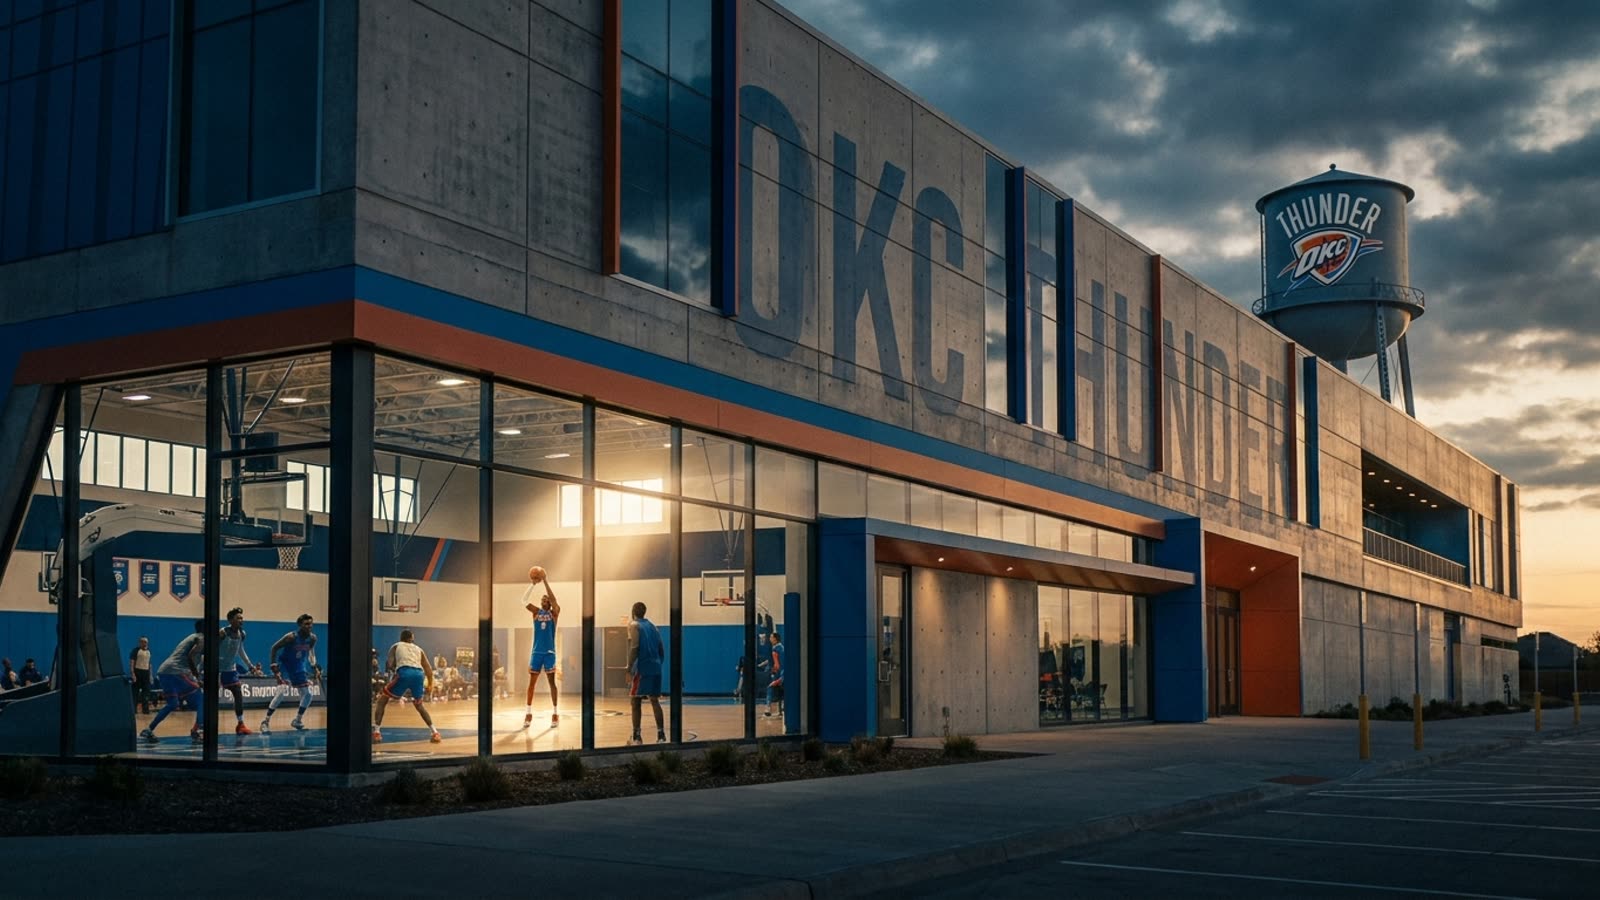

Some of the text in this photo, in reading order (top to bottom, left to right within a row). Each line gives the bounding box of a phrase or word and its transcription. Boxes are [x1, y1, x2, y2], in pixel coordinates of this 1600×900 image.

[1276, 193, 1382, 239] THUNDER
[735, 85, 964, 414] OKC
[1294, 239, 1348, 279] OKC
